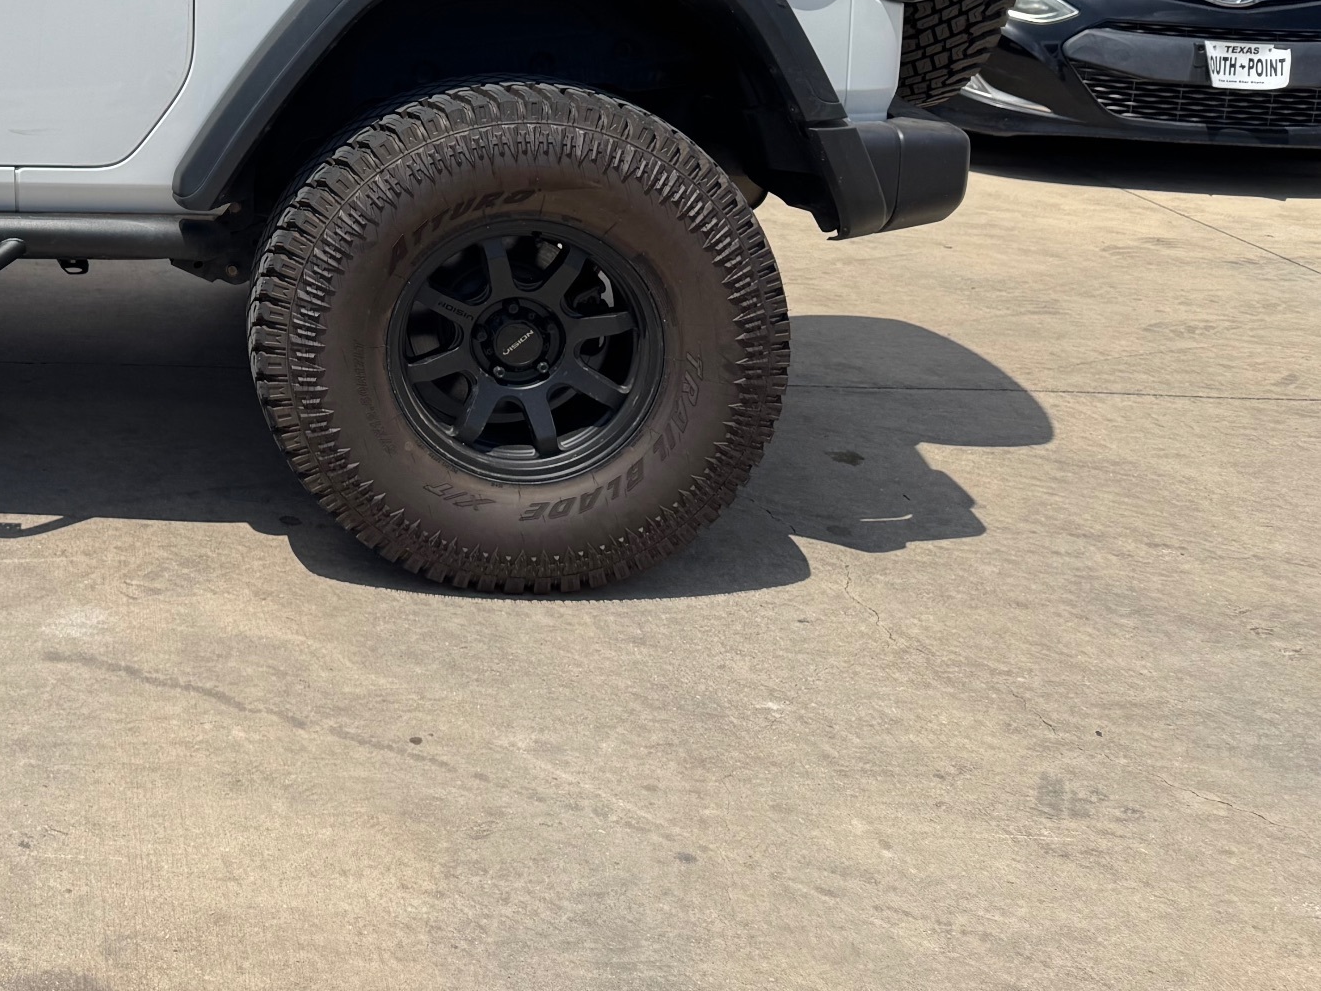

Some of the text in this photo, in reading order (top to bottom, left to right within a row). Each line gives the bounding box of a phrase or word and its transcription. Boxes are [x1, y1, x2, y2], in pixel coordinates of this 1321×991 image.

[1225, 45, 1260, 55] TEXAS
[1247, 57, 1286, 77] POINT
[387, 188, 538, 277] ATTURO
[502, 329, 535, 356] VISION
[652, 351, 704, 462] TRAIL
[518, 458, 645, 523] BLADE
